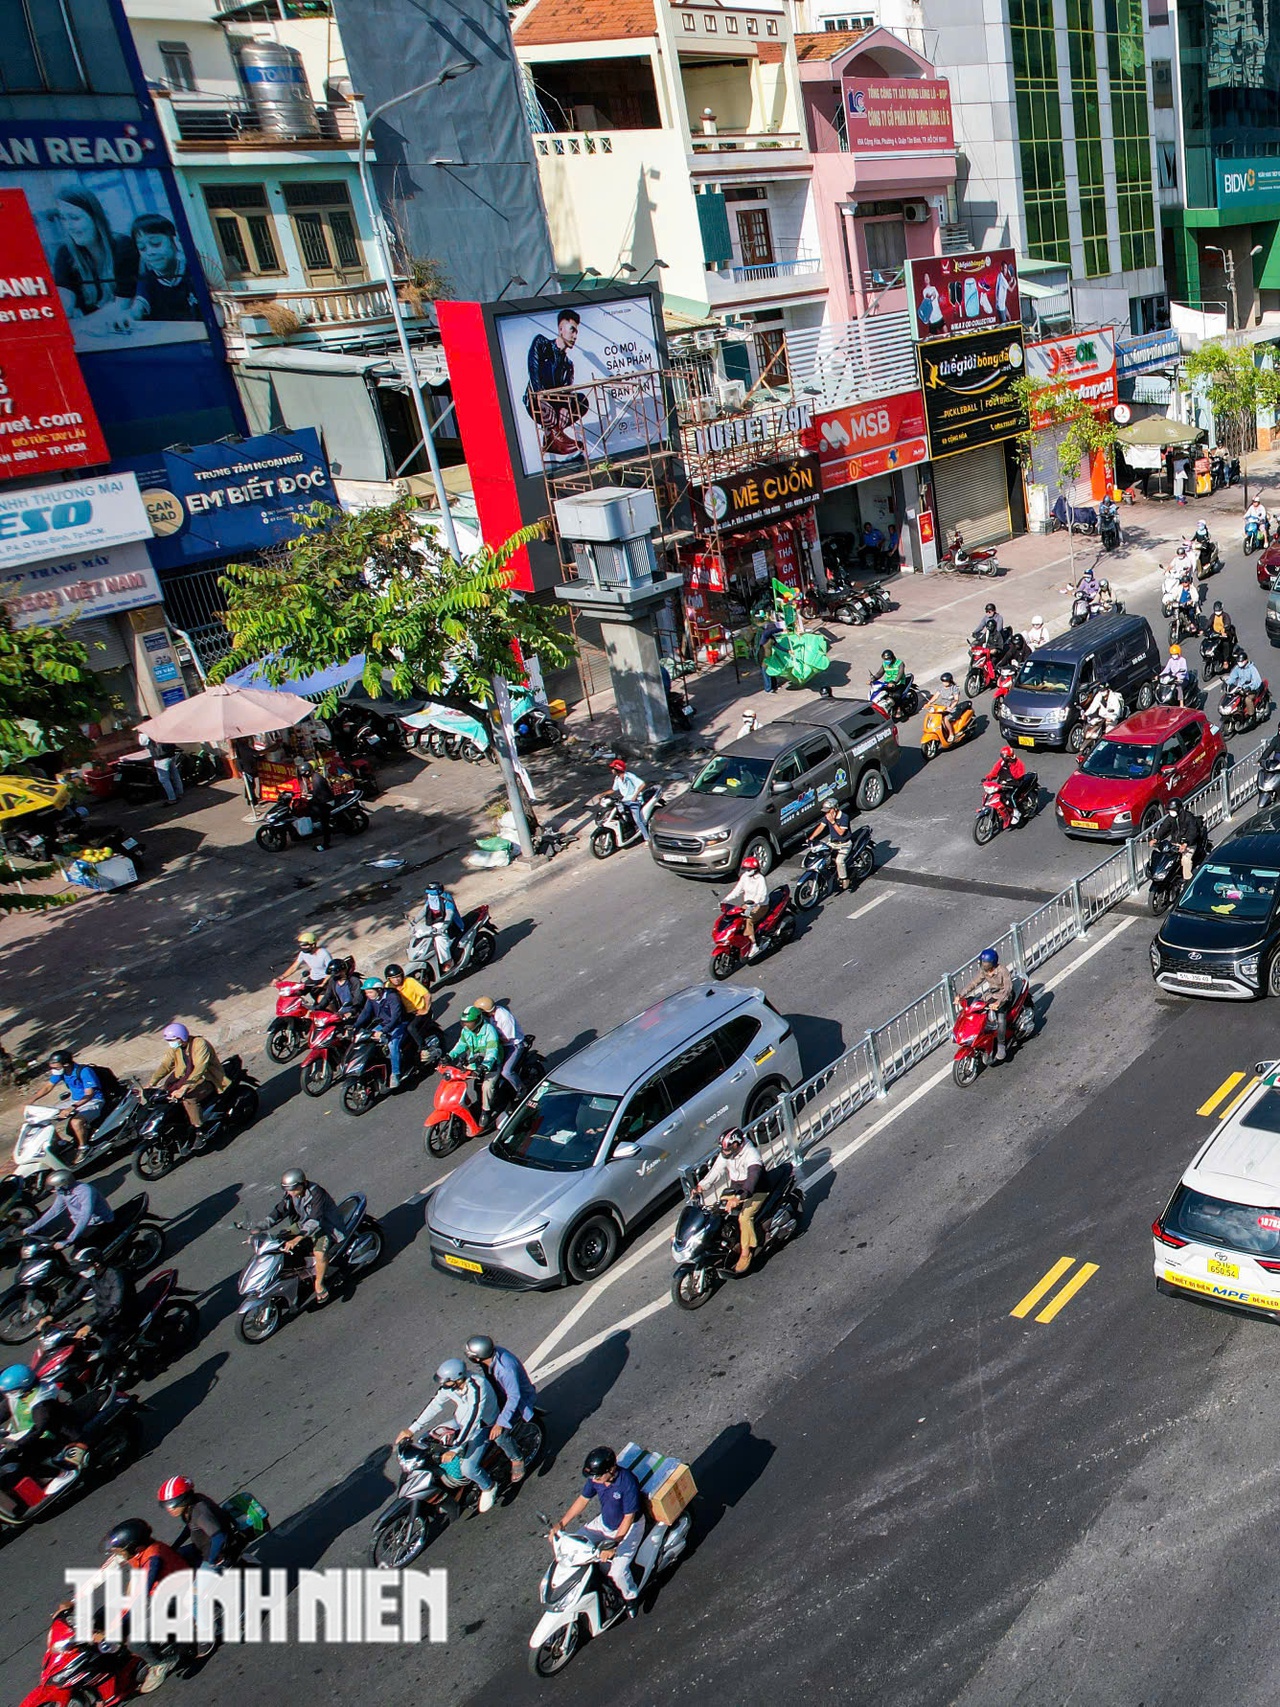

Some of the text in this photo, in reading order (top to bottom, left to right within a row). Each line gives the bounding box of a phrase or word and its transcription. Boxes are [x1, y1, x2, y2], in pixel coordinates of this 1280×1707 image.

[43, 137, 144, 165] READ
[1224, 173, 1248, 193] BIDV
[19, 307, 41, 320] B2
[619, 341, 637, 355] MỌI
[850, 409, 890, 442] MSB
[194, 466, 231, 481] TRUNG
[231, 462, 254, 475] TÂM
[253, 458, 283, 471] NGOẠI
[31, 485, 95, 504] THƯƠNG
[97, 481, 124, 497] MẠI
[185, 489, 223, 514] EM
[226, 475, 275, 505] BIẾT
[731, 478, 760, 510] MÊ
[763, 461, 814, 500] CUỐN
[29, 553, 110, 580] THANG MÁY
[104, 572, 147, 594] NAM
[1212, 1286, 1250, 1302] MPE
[1266, 1299, 1279, 1307] LED
